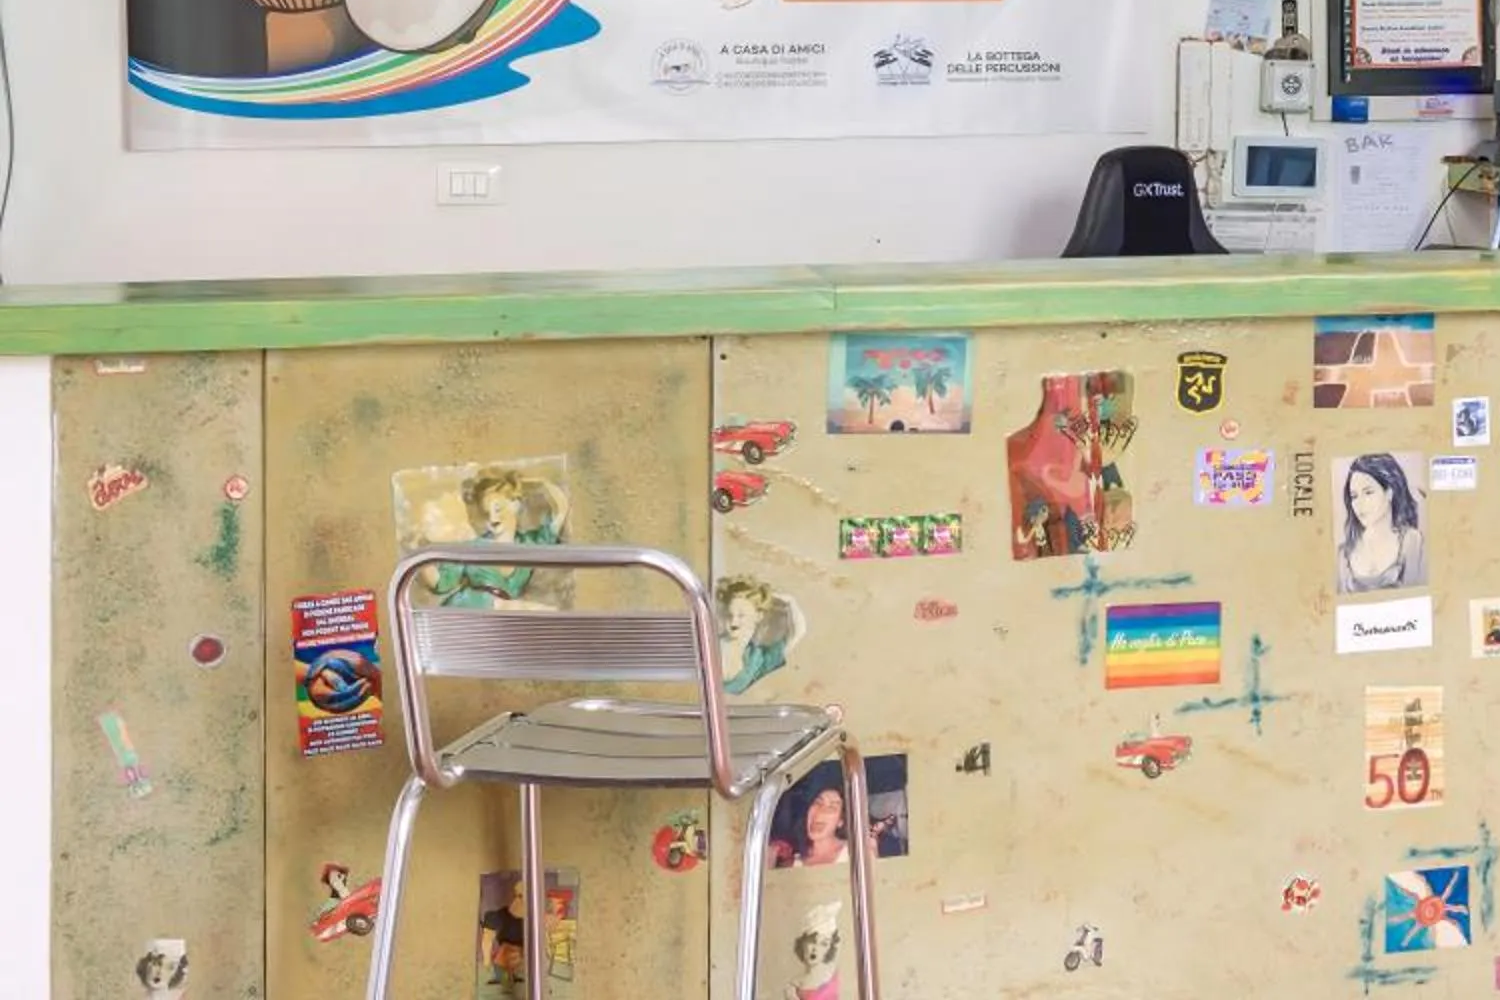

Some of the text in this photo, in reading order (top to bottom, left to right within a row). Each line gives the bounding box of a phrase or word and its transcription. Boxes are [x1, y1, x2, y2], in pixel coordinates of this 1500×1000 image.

[720, 43, 825, 55] A CASA DI AMICI
[968, 51, 1041, 62] LA BOTTEGA
[947, 63, 1061, 74] DELLE PERCUSSIONI
[1294, 452, 1315, 517] LOCALE
[1364, 747, 1430, 809] 50
